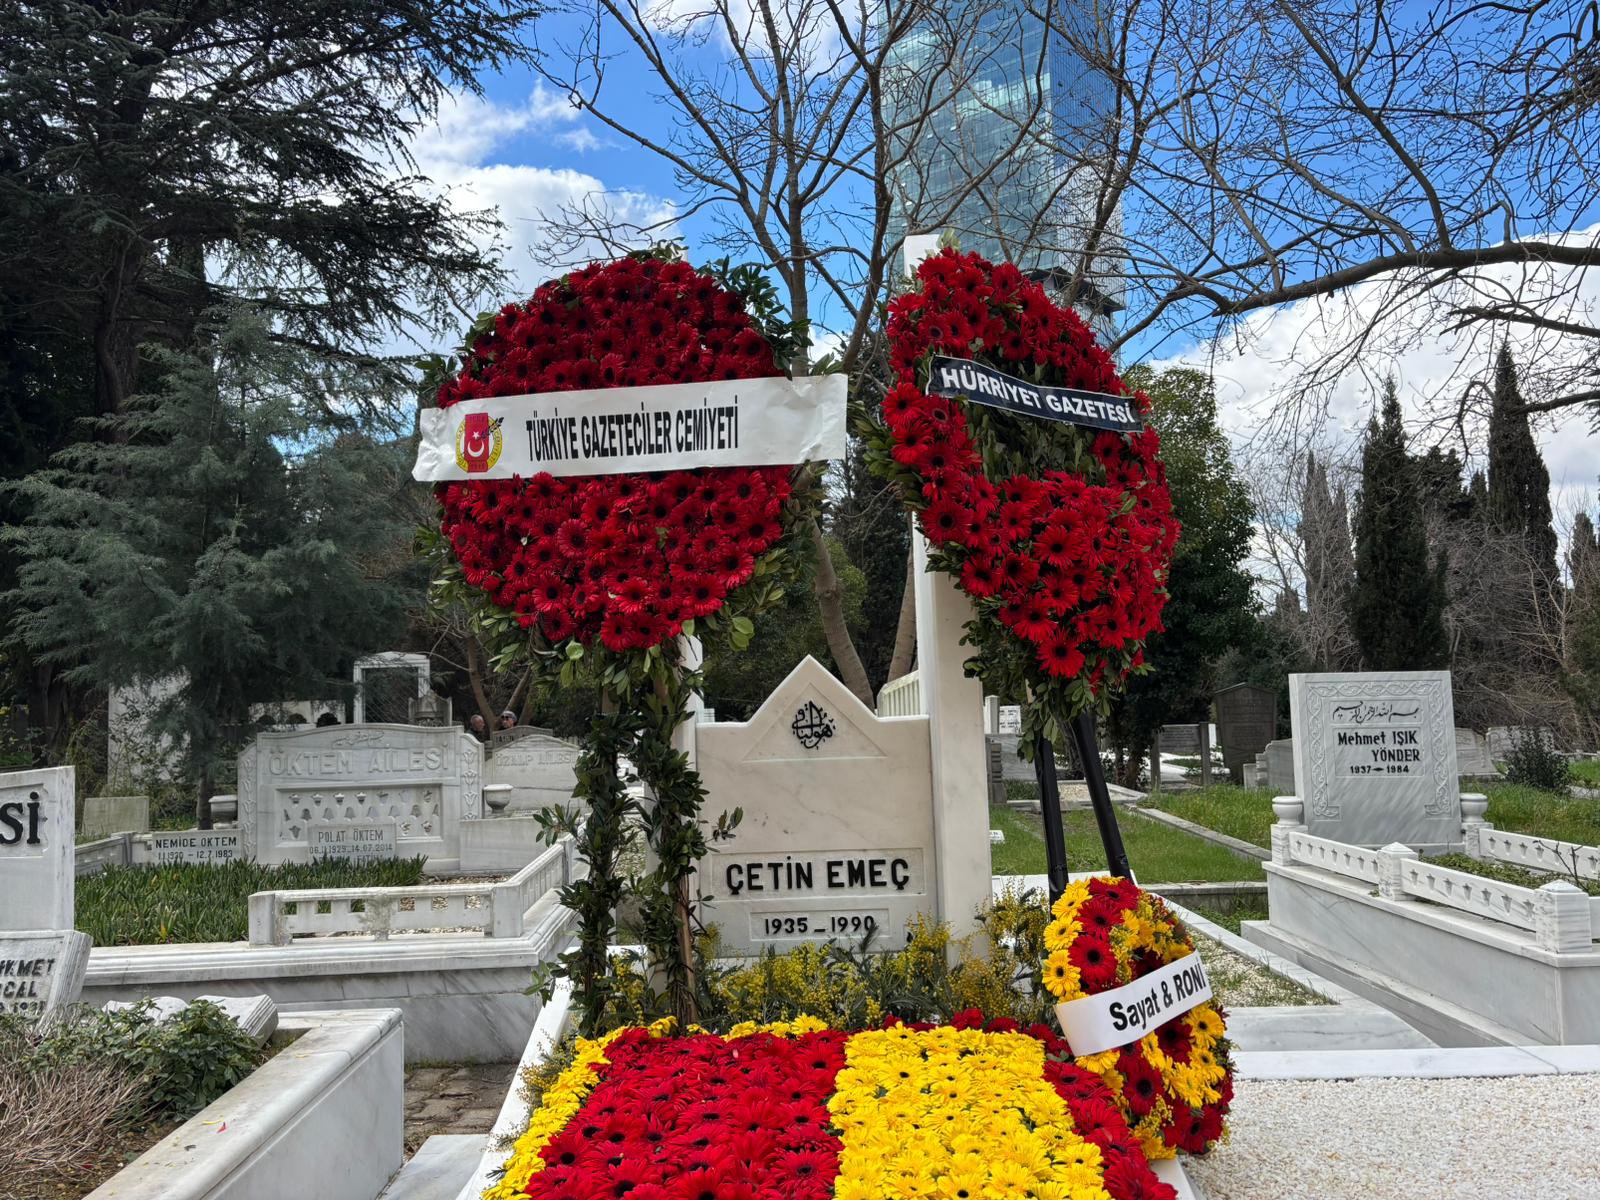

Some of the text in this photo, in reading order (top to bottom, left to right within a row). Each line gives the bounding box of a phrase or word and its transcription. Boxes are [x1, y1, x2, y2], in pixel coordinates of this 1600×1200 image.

[940, 365, 1136, 423] HÜRRİYET GAZETESİ
[526, 406, 578, 462] TÜRKİYE
[581, 401, 673, 460] GAZETECİLER
[675, 395, 739, 453] CEMİYETİ
[1337, 730, 1418, 746] Mehmet IŞIK
[269, 741, 450, 776] ÖKTEM AİLESİ
[1371, 747, 1421, 762] YÖNDER
[1350, 765, 1410, 774] 1937 1984
[0, 791, 40, 844] Sİ
[155, 836, 197, 849] NEMİDE
[318, 828, 384, 843] POLAT ÖKTEM
[726, 855, 910, 895] ÇETİN EMEÇ
[765, 917, 808, 935] 1935
[831, 915, 876, 934] 1990
[1109, 988, 1162, 1031] Sayat
[1161, 980, 1174, 1008] &
